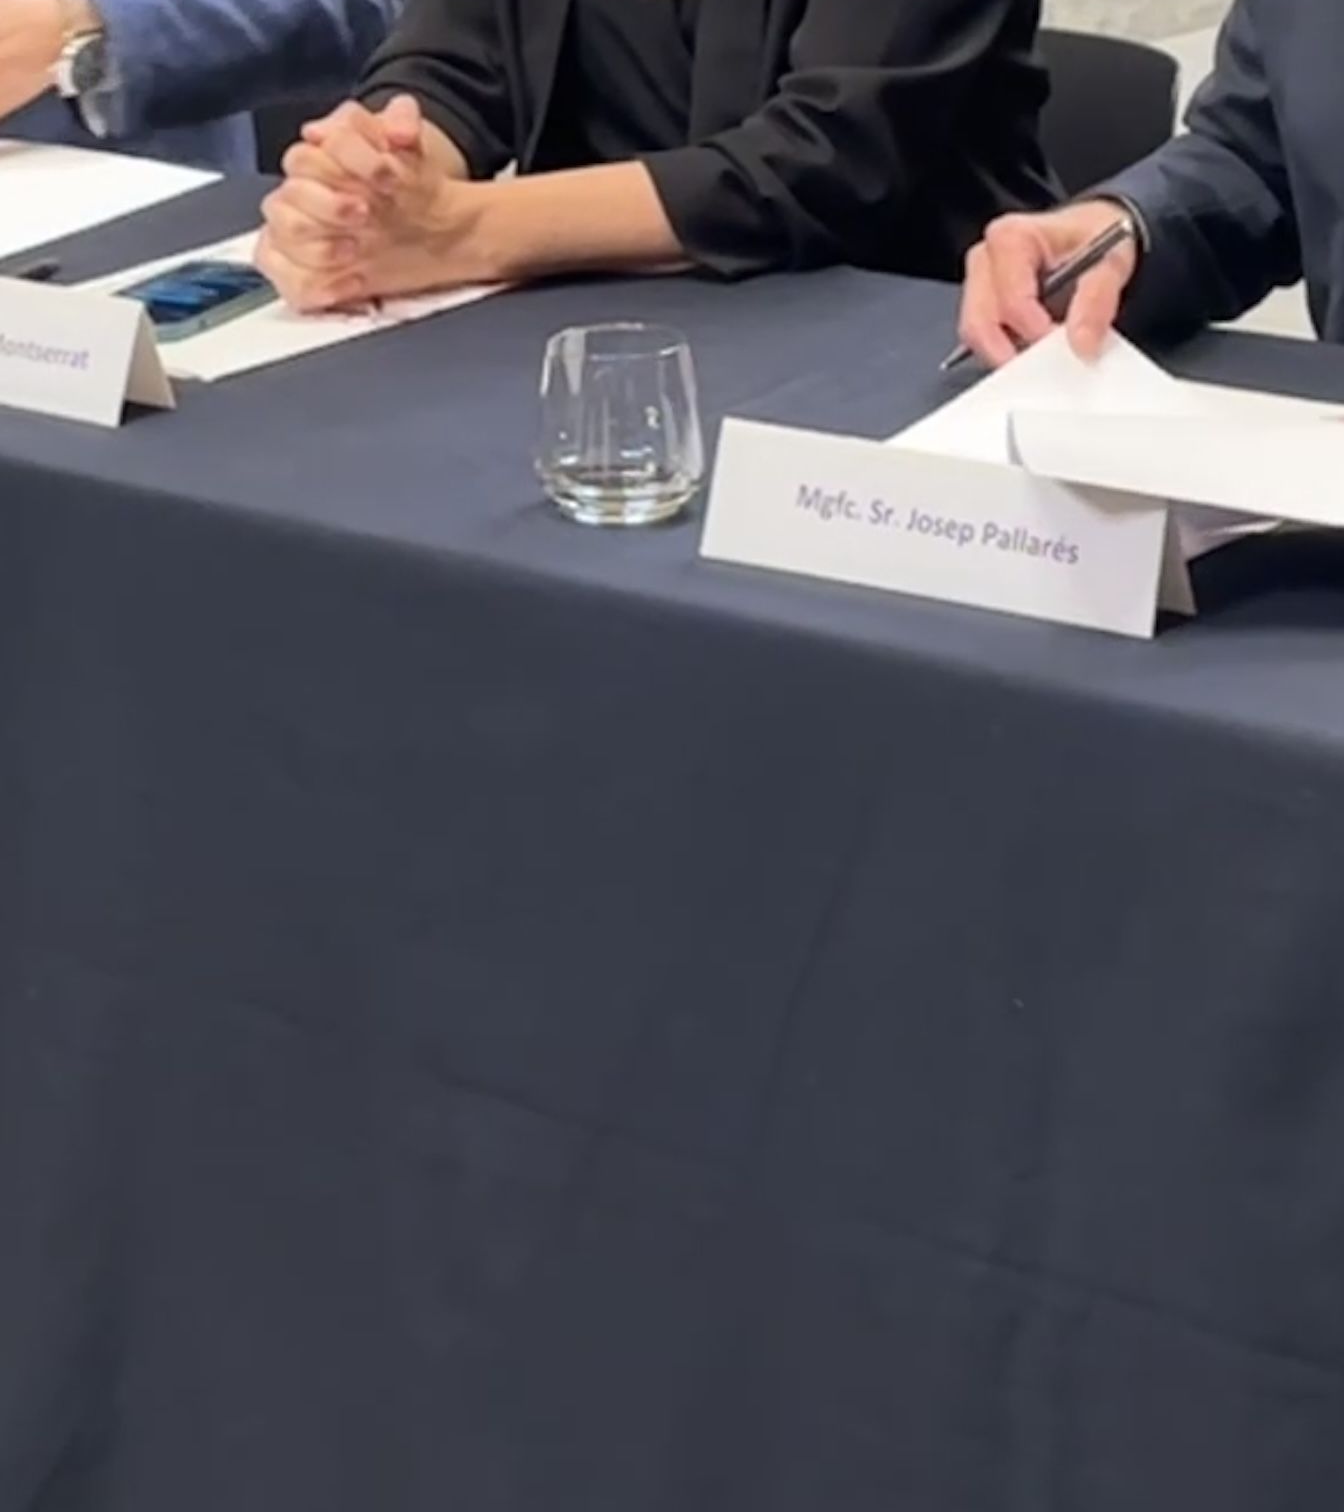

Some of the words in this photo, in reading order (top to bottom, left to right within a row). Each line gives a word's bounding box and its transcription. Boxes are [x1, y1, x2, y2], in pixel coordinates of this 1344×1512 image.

[795, 484, 861, 520] Mgfc.
[868, 498, 900, 527] Sr.
[907, 508, 975, 546] Josep
[981, 521, 1080, 565] Pallarés
